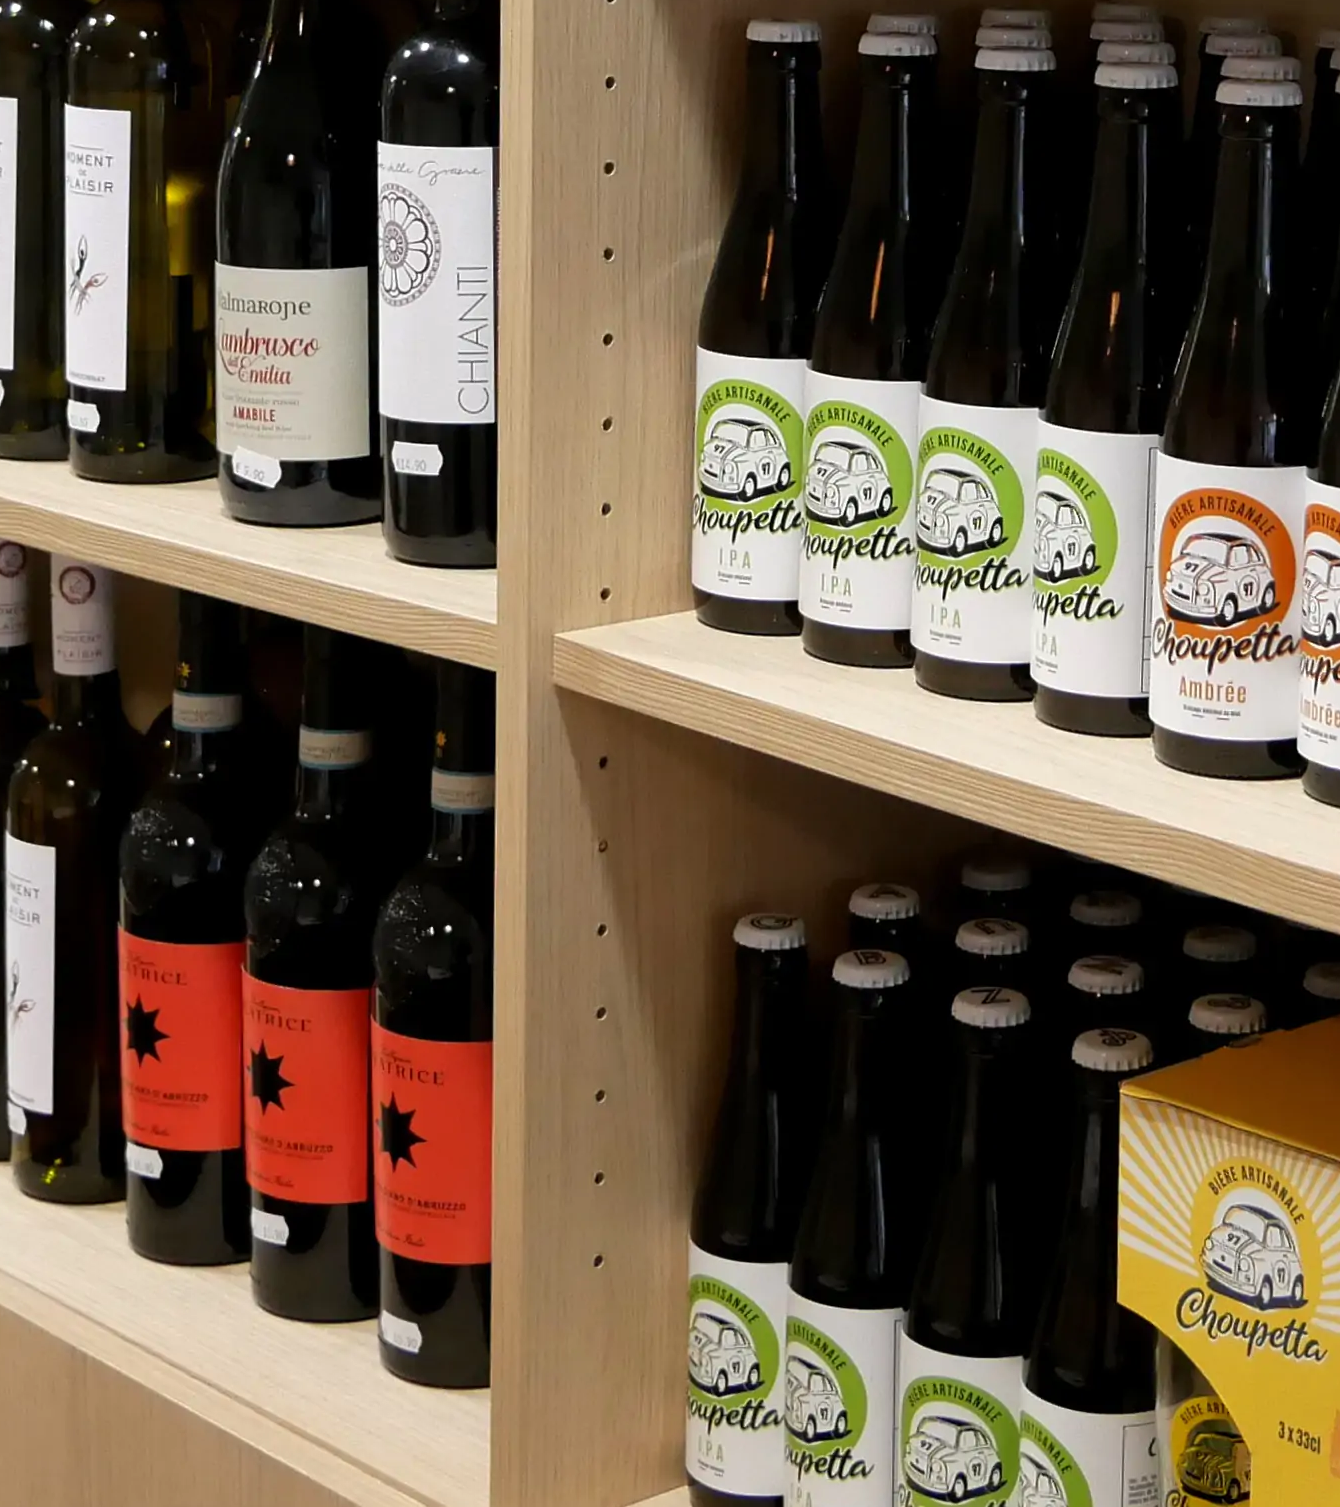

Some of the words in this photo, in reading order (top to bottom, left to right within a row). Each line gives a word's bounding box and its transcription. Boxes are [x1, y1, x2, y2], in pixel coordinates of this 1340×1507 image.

[456, 265, 490, 415] CHIANTI
[238, 354, 292, 385] Emilia
[233, 405, 276, 423] AMABILE
[725, 386, 791, 423] ARTISANALE
[827, 407, 894, 448] ARTISANALE
[713, 444, 725, 455] 97
[937, 433, 1004, 477] ARTISANALE
[761, 460, 771, 475] 97
[816, 467, 828, 478] 97
[862, 485, 872, 501] 97
[971, 515, 983, 531] 97
[1169, 499, 1195, 529] BIÈRE
[1199, 496, 1277, 537] ARTISANALE
[804, 522, 915, 570] houpetta
[1184, 562, 1199, 573] 97
[1243, 581, 1253, 596] 97
[1152, 617, 1301, 675] Choupetta
[1179, 676, 1247, 703] Ambrée
[1208, 1166, 1238, 1196] BIÈRE
[1241, 1165, 1305, 1226] ARTISANALE
[1226, 1232, 1241, 1245] 97
[1277, 1268, 1286, 1283] 97
[701, 1282, 760, 1325] ARTISANALE
[1176, 1287, 1328, 1362] Choupetta
[932, 1382, 1003, 1424] ARTISANALE
